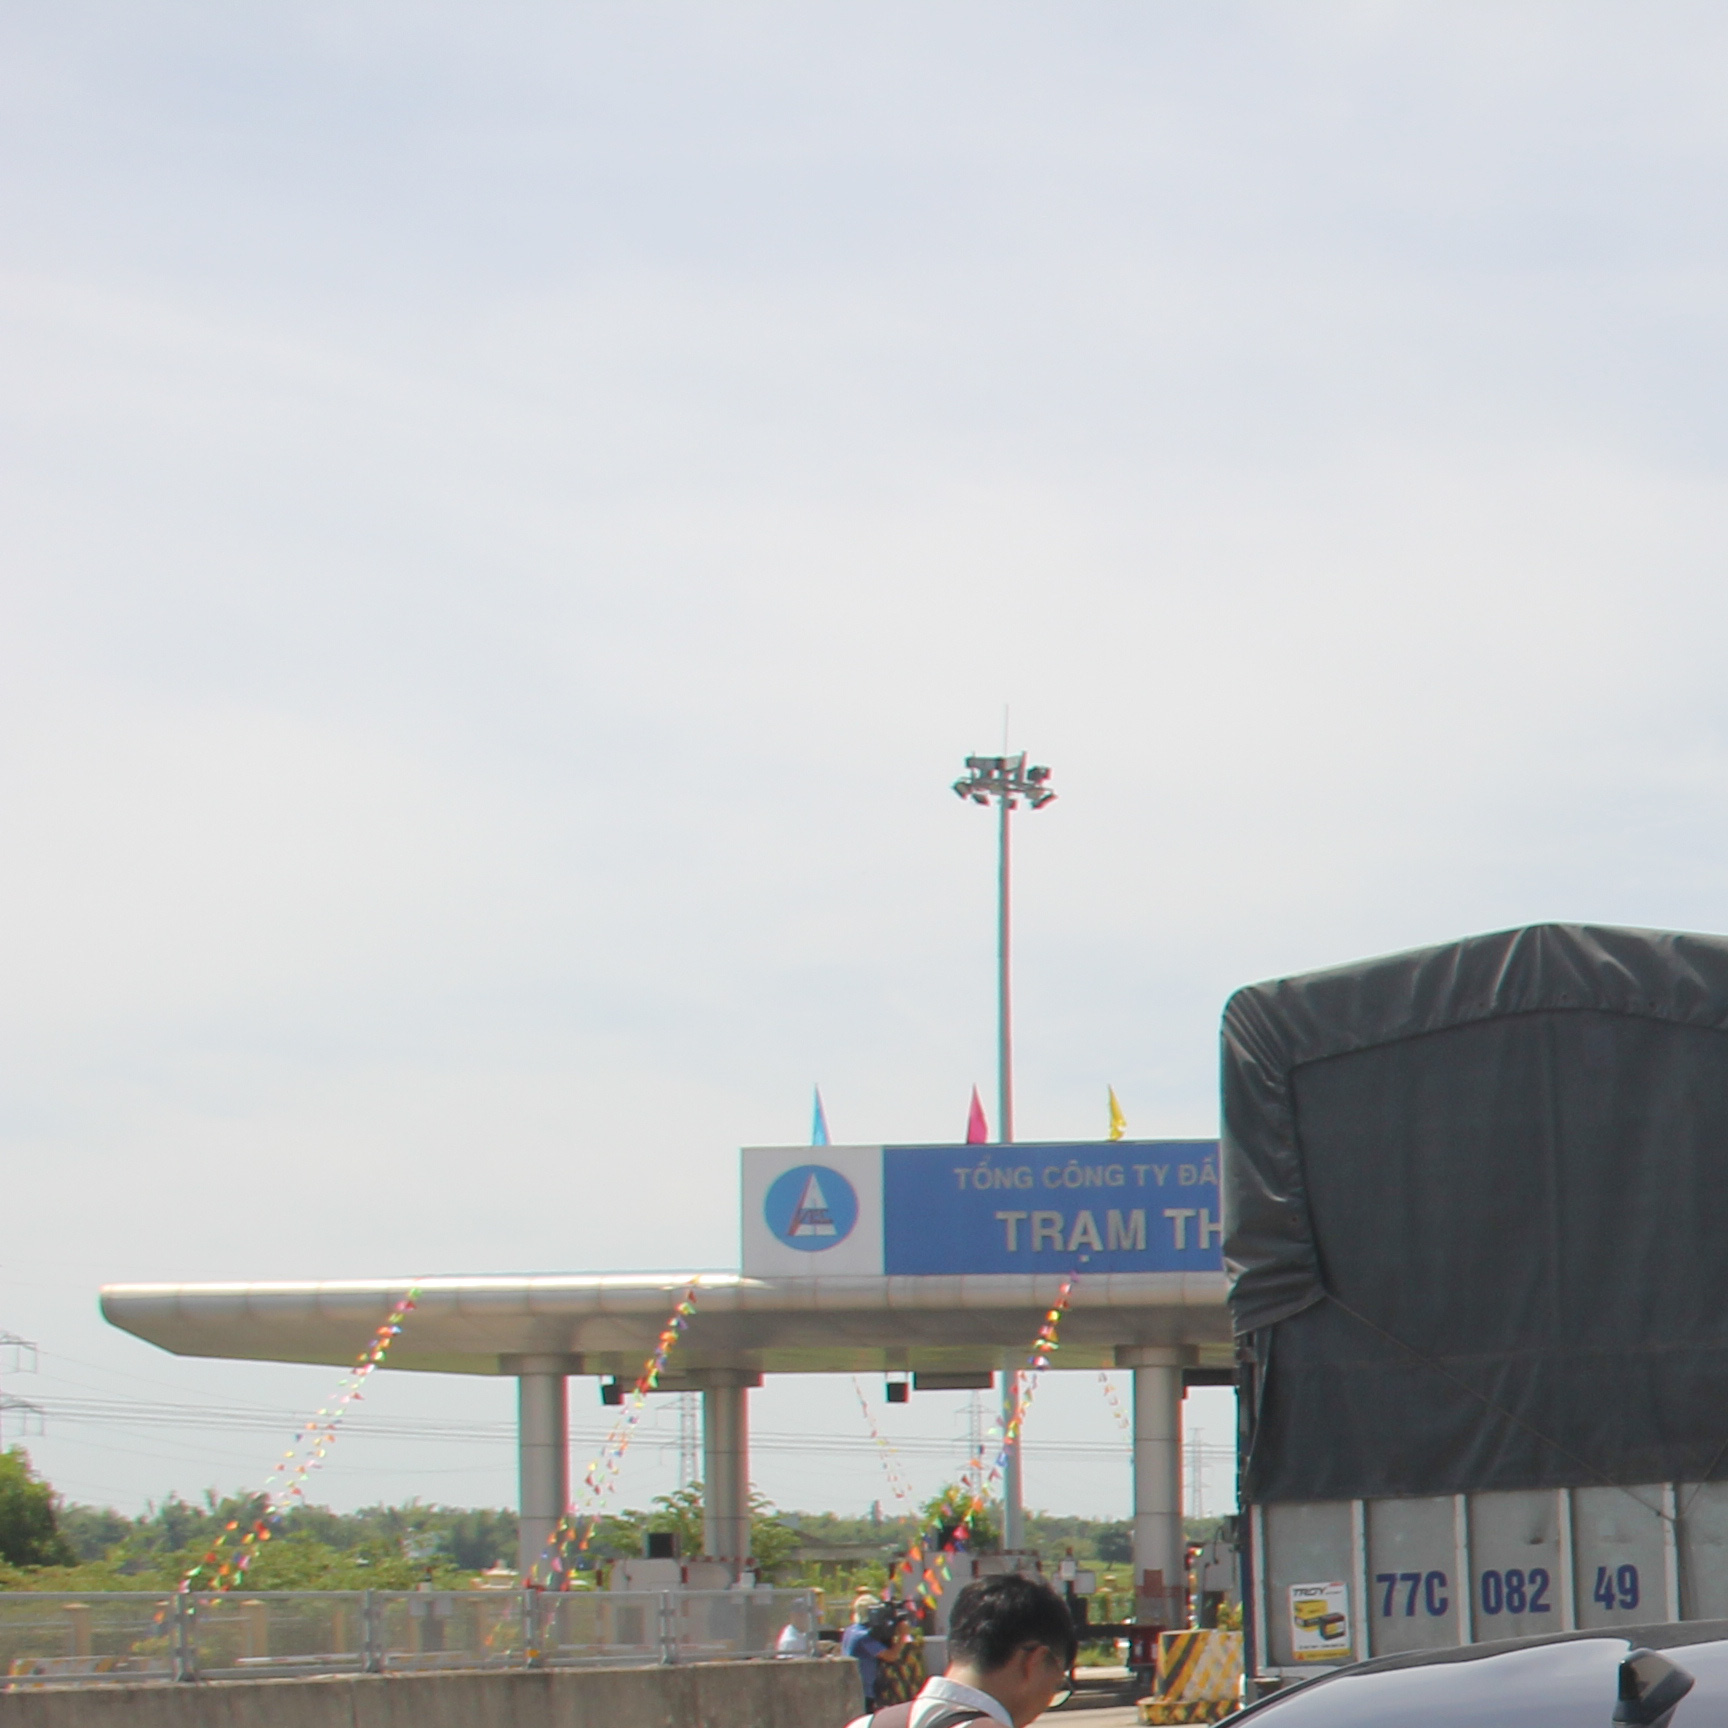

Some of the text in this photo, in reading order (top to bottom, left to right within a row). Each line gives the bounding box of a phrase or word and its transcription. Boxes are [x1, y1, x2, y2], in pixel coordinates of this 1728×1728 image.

[953, 1156, 1034, 1191] TỔNG
[1042, 1158, 1126, 1189] CÔNG
[1133, 1165, 1169, 1187] TY
[995, 1208, 1147, 1263] TRẠM
[1376, 1563, 1640, 1618] 77C 082 49
